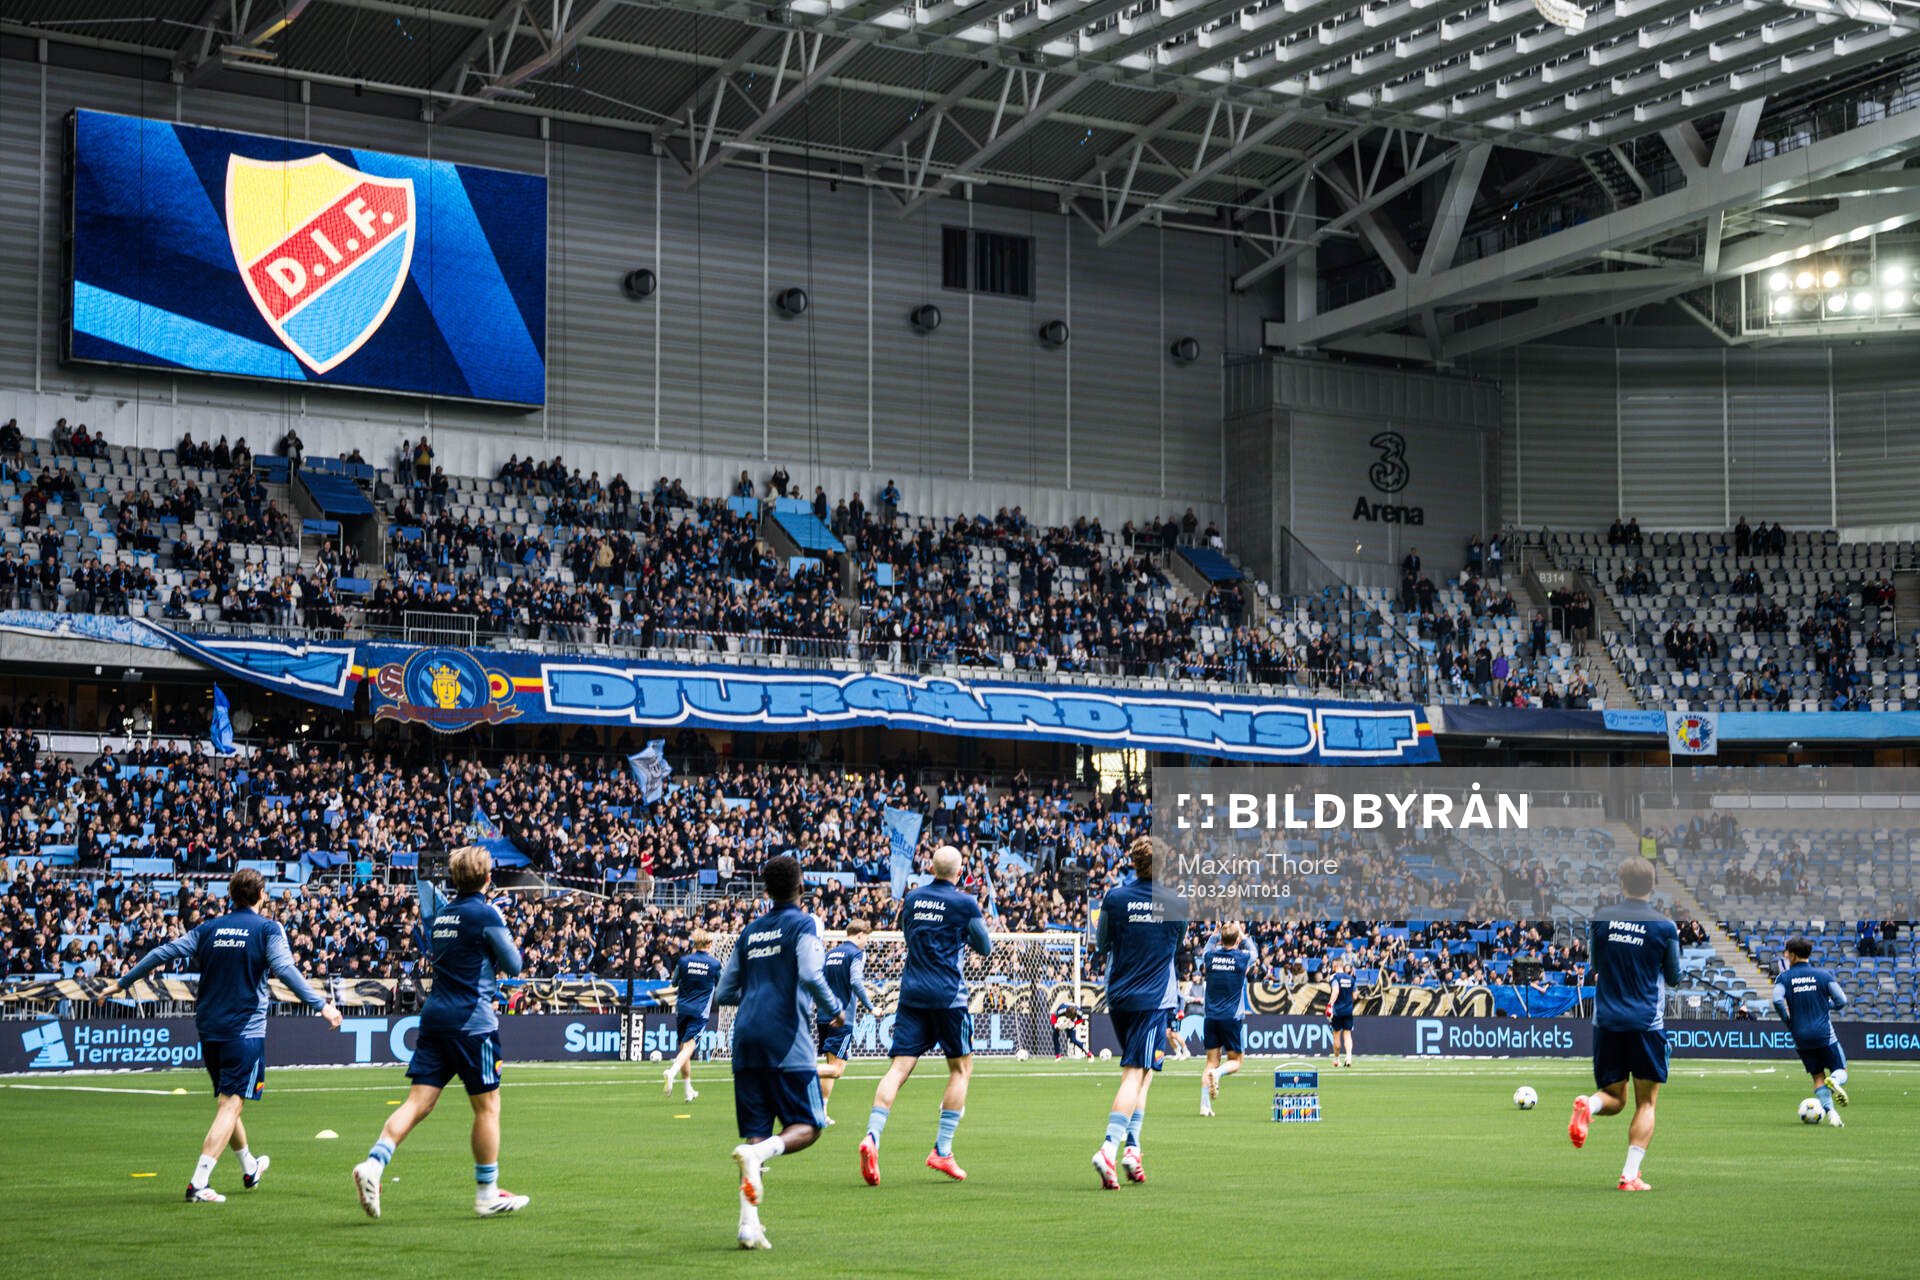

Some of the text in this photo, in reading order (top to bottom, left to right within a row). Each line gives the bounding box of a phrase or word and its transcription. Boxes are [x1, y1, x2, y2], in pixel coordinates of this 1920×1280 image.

[264, 195, 395, 299] D.I.F.
[1352, 496, 1424, 526] Arena
[1539, 572, 1566, 584] B314
[545, 668, 1414, 753] DJURGÅRDENS IF
[913, 900, 946, 911] MOBILL
[913, 911, 944, 922] stadium
[215, 927, 250, 937] MOBILL
[1608, 920, 1647, 934] MOBILL
[213, 938, 246, 948] stadium
[1608, 933, 1645, 946] stadium
[74, 1024, 170, 1051] Haninge
[630, 1013, 644, 1062] SELECT
[1449, 1025, 1574, 1049] RoboMarkets
[1865, 1033, 1920, 1049] ELGIGA
